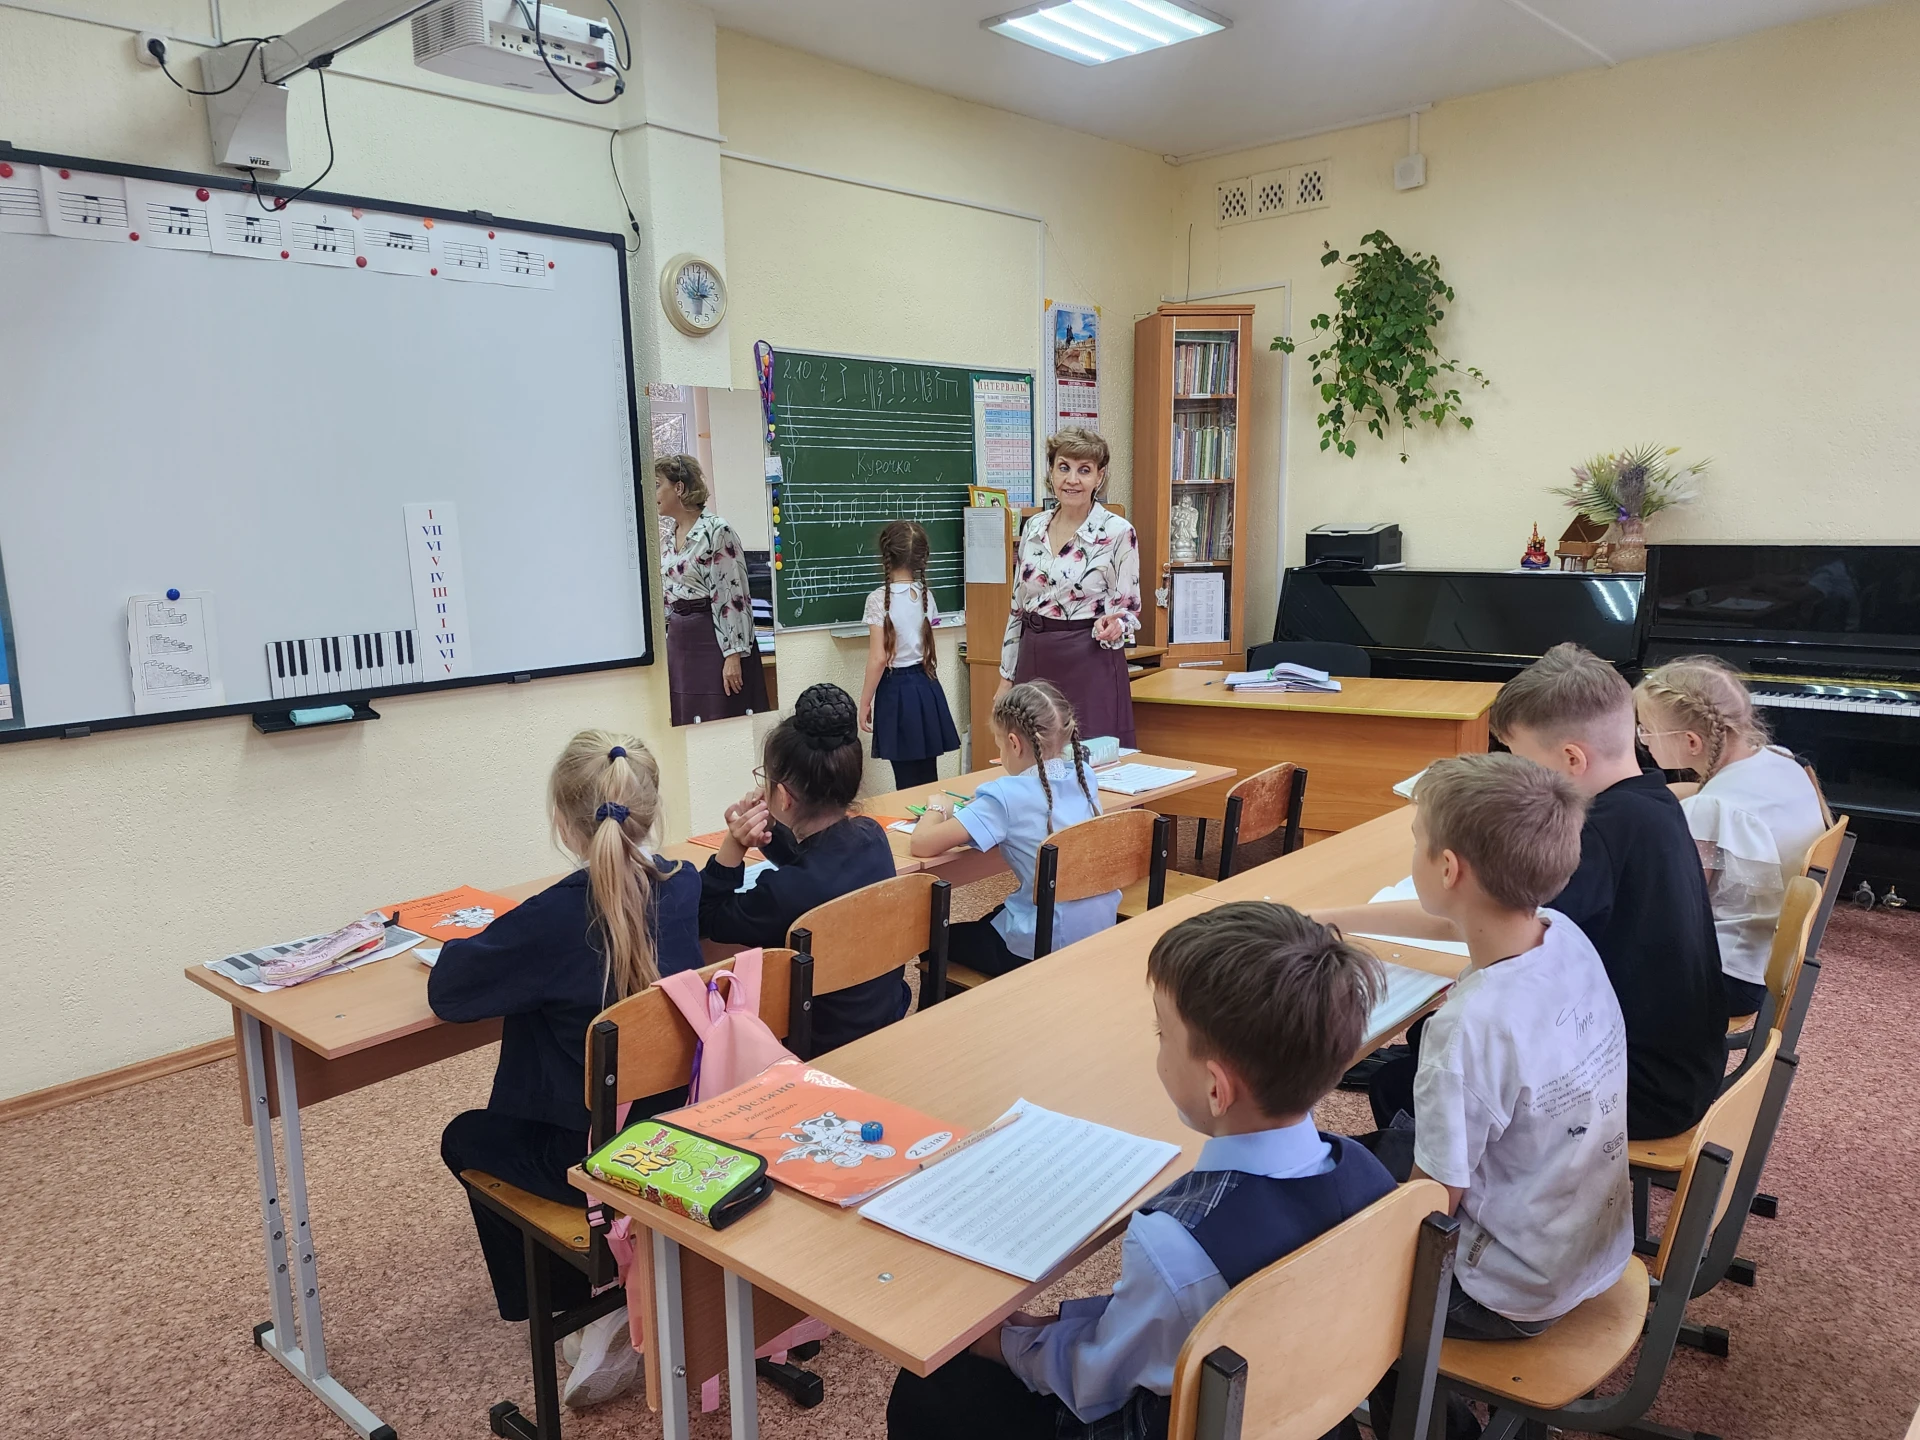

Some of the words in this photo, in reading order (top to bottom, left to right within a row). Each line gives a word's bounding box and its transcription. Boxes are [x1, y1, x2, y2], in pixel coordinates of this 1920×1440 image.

[322, 214, 328, 224] 3
[683, 267, 690, 276] 11
[692, 265, 701, 274] 12
[704, 270, 708, 279] 1
[708, 281, 715, 290] 2
[713, 293, 719, 302] 3
[677, 300, 683, 309] 8
[710, 305, 716, 313] 4
[685, 310, 690, 318] 7
[694, 315, 700, 323] 6
[704, 313, 710, 321] 5
[977, 381, 1027, 393] ИНТЕРВАЛЫ
[428, 509, 433, 520] I
[421, 525, 443, 536] VII
[426, 540, 442, 551] VI
[431, 556, 440, 566] V
[430, 571, 445, 583] IV
[432, 586, 448, 598] III
[436, 603, 447, 614] II
[441, 618, 446, 628] I
[435, 633, 456, 645] VII
[439, 648, 455, 659] VI
[444, 663, 453, 673] V
[1556, 996, 1595, 1041] Time
[697, 1082, 796, 1128] Сольфеджио
[744, 1105, 776, 1122] Рабочая
[764, 1102, 798, 1121] тетрадь
[920, 1132, 951, 1151] класс
